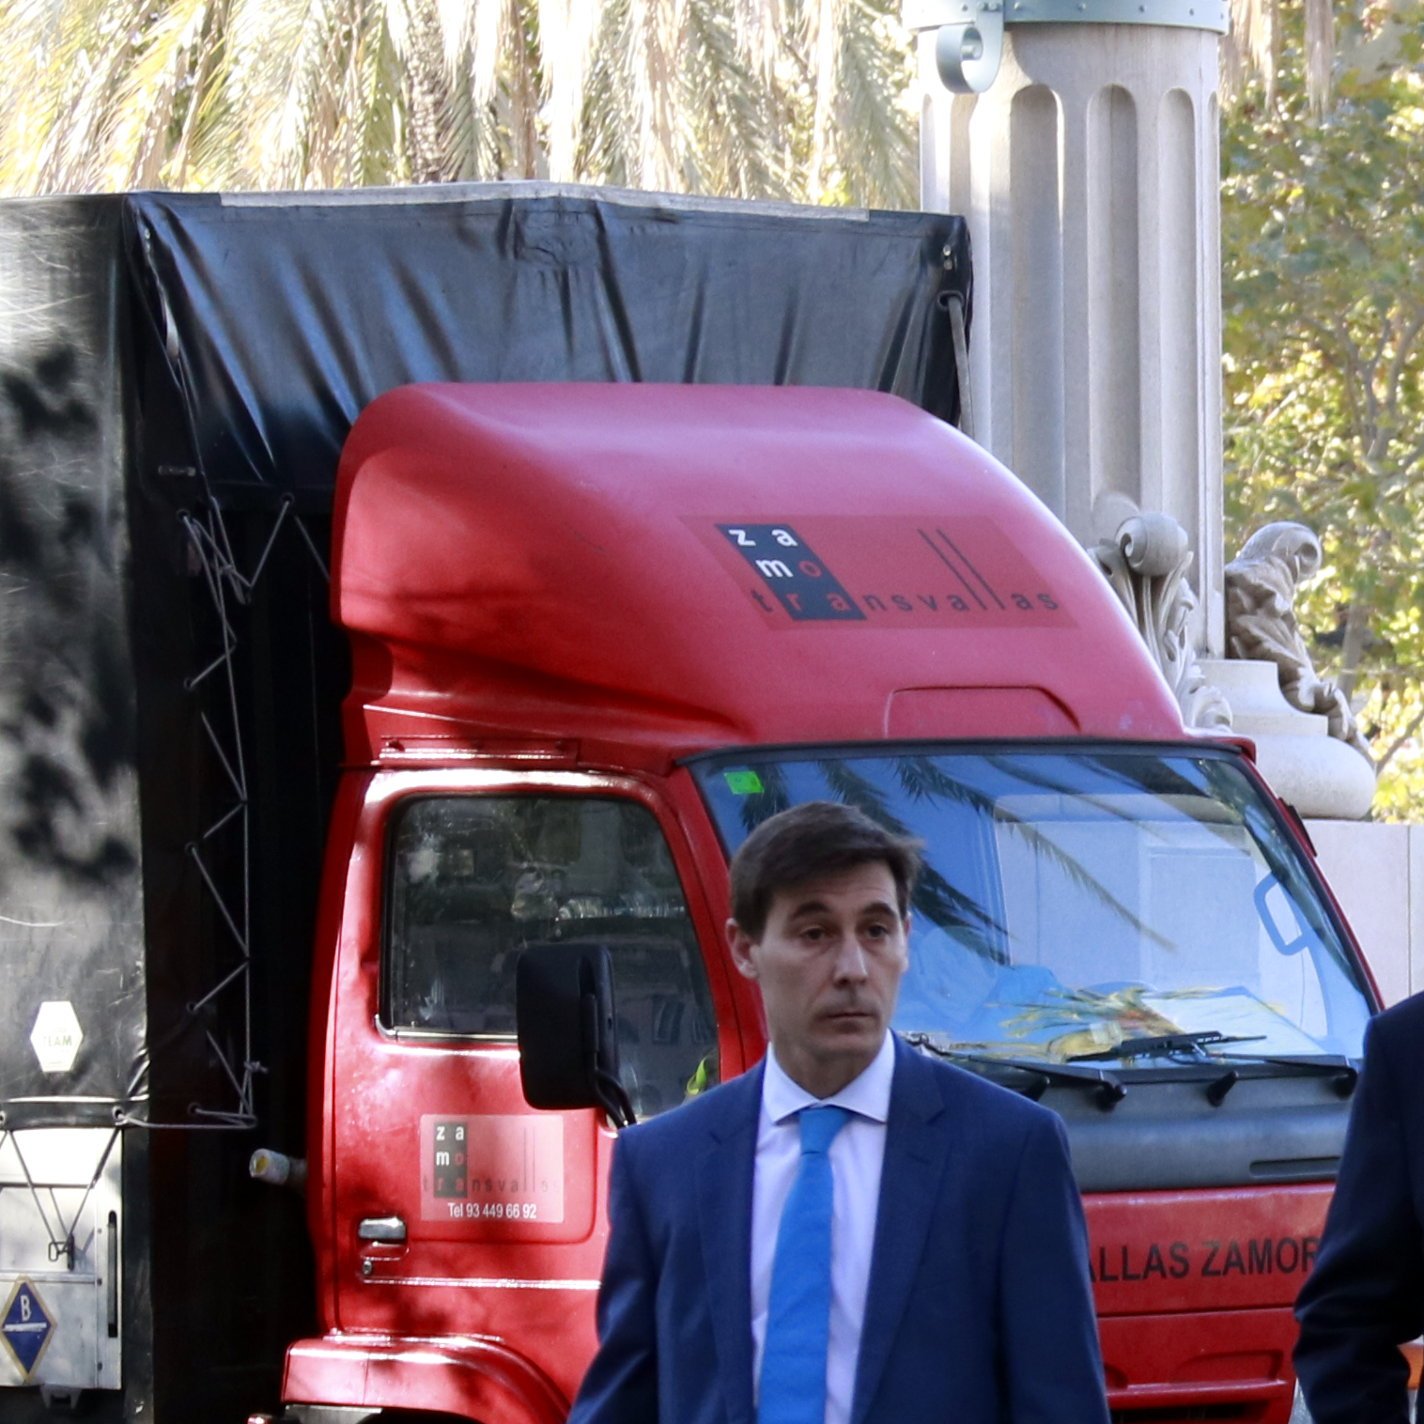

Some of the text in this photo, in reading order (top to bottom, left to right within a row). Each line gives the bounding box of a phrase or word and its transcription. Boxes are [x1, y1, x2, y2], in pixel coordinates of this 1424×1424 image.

[448, 1202, 536, 1219] Tel 93 449 66 92
[1090, 1241, 1190, 1282] LLAS
[20, 1295, 31, 1321] B
